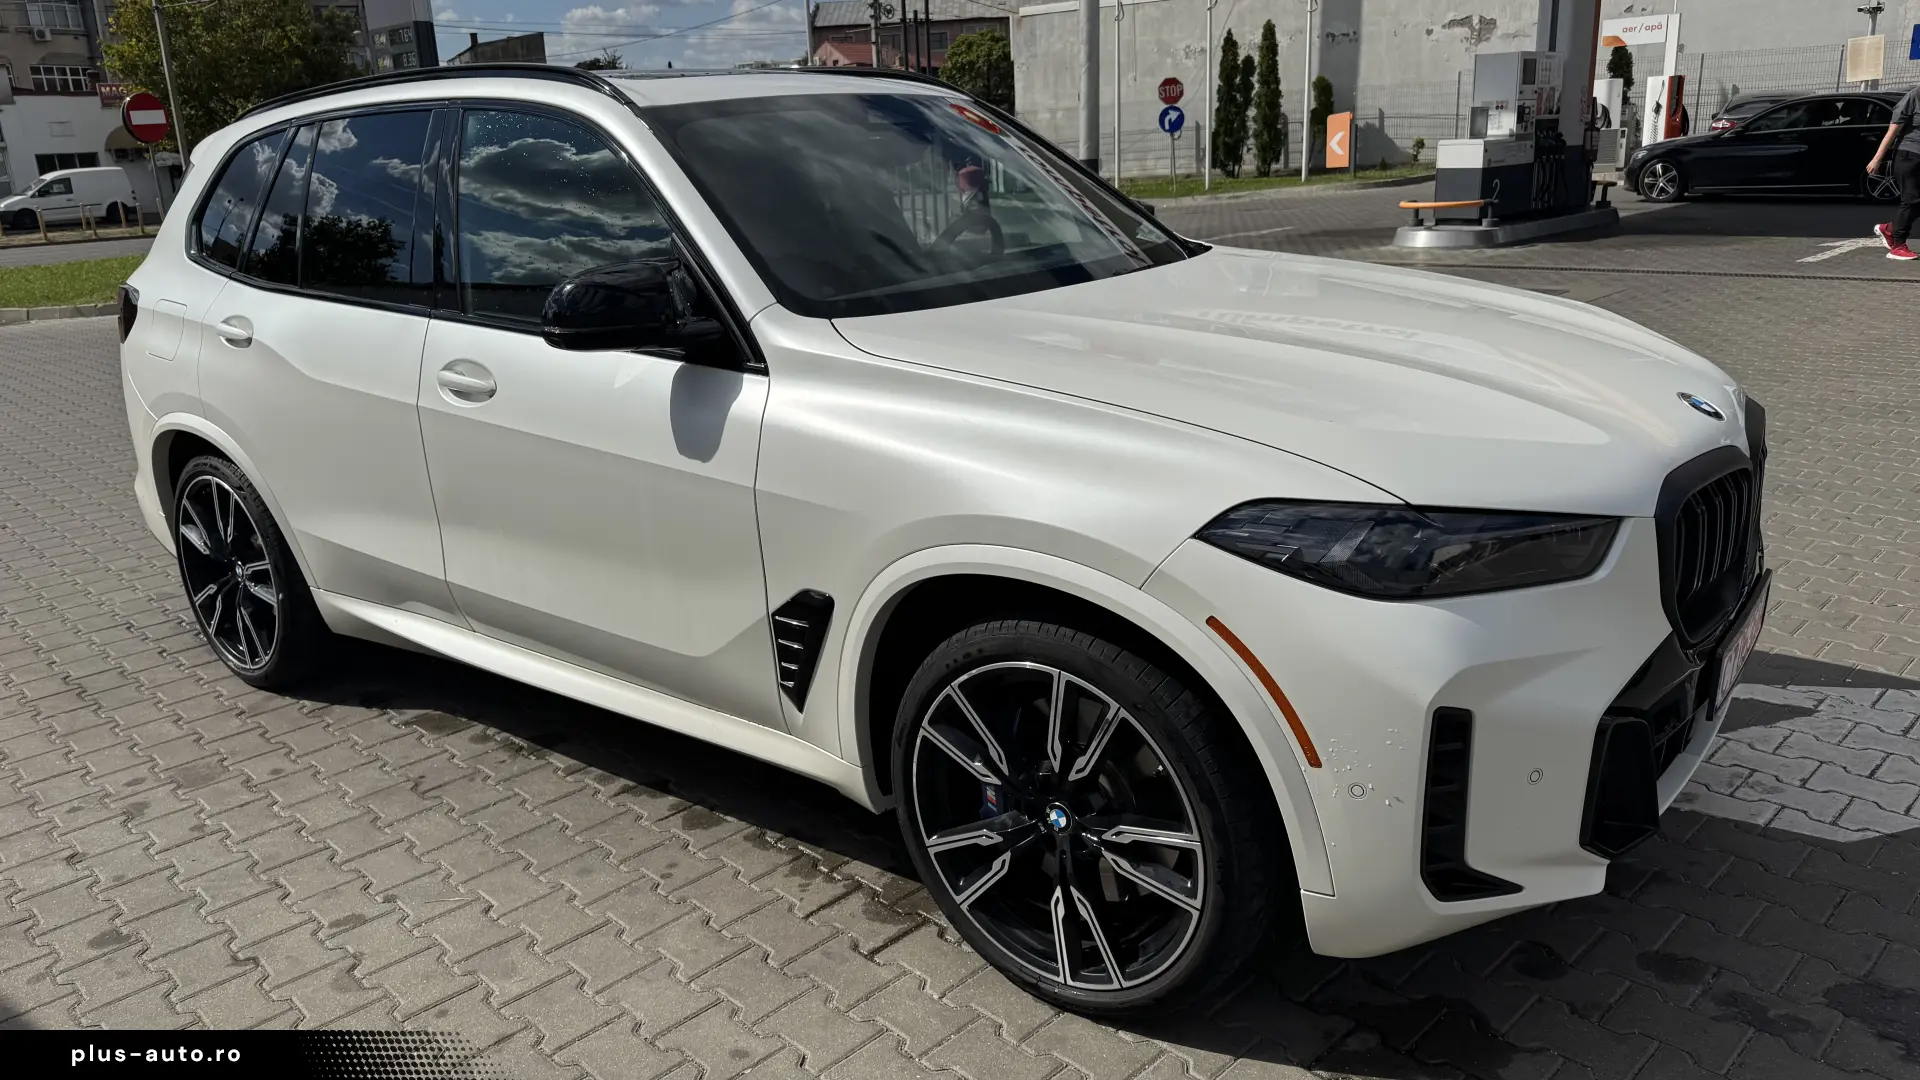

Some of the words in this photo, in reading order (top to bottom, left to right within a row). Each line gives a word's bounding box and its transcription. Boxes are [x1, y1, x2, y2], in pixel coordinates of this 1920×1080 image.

[1622, 25, 1638, 33] aer
[1159, 84, 1182, 98] STOP
[1492, 179, 1499, 203] 2
